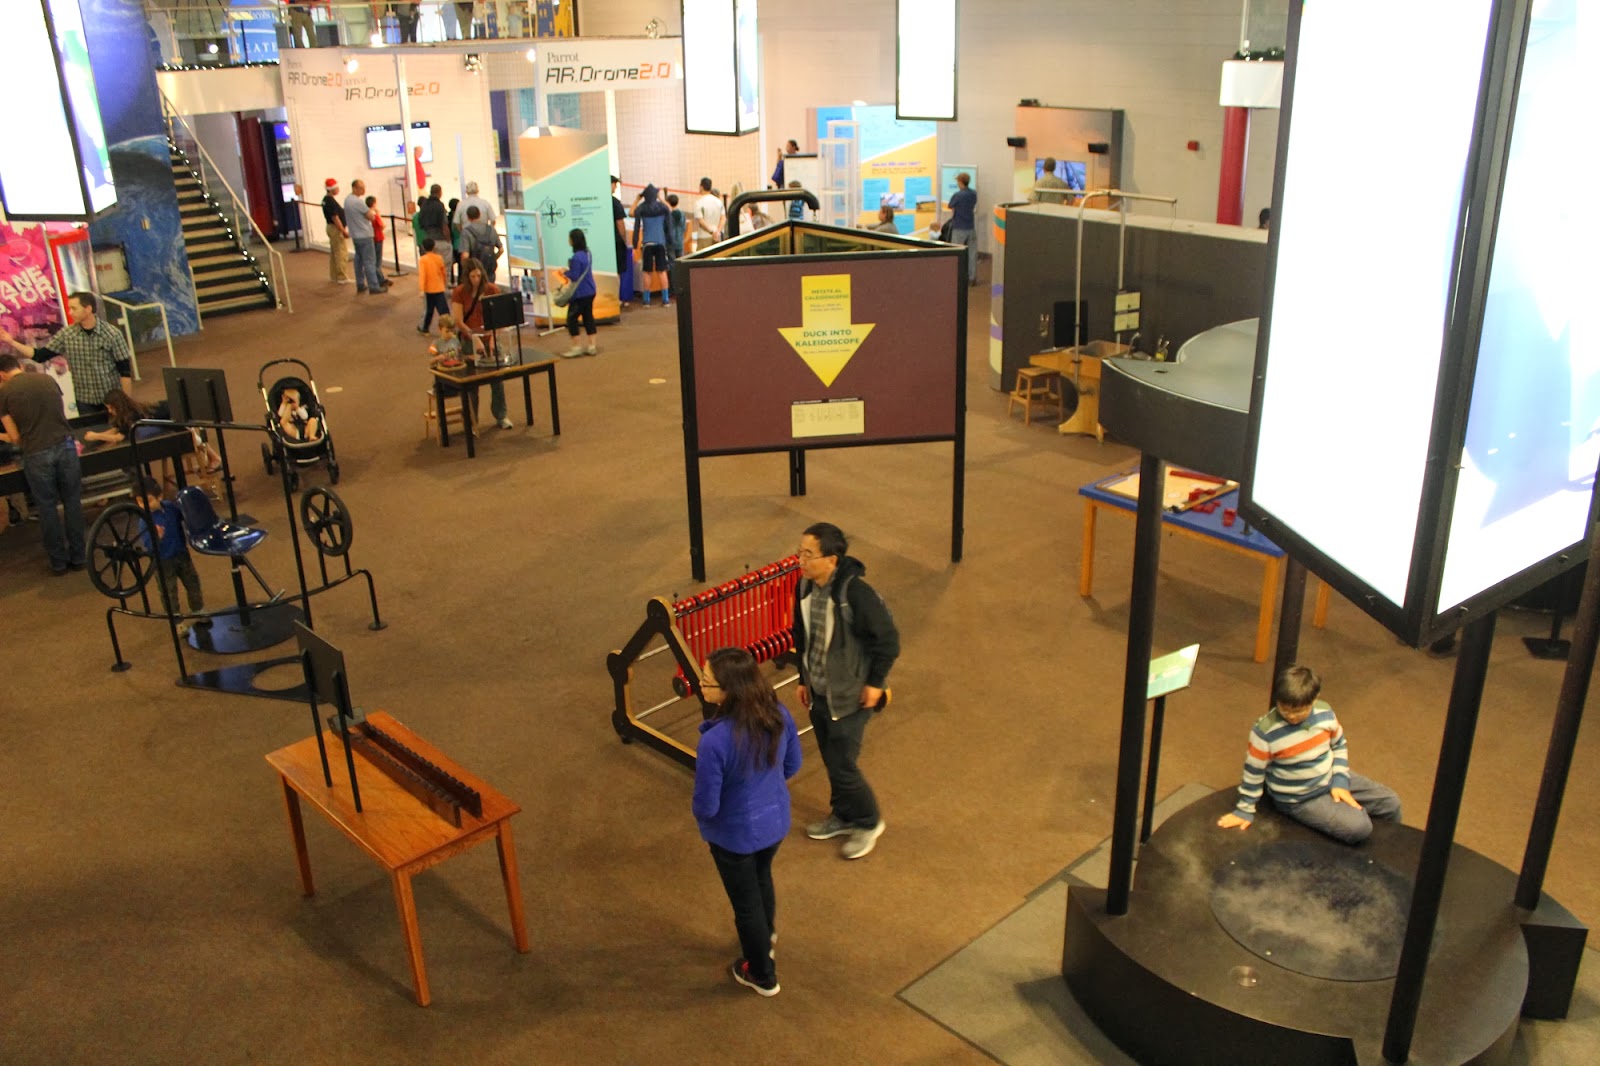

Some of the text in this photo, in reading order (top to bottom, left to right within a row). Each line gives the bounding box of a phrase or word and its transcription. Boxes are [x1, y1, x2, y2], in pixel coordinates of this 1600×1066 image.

[547, 51, 579, 63] Parrot
[803, 330, 828, 338] DUCK
[795, 338, 860, 347] KALEIDOSCOPE
